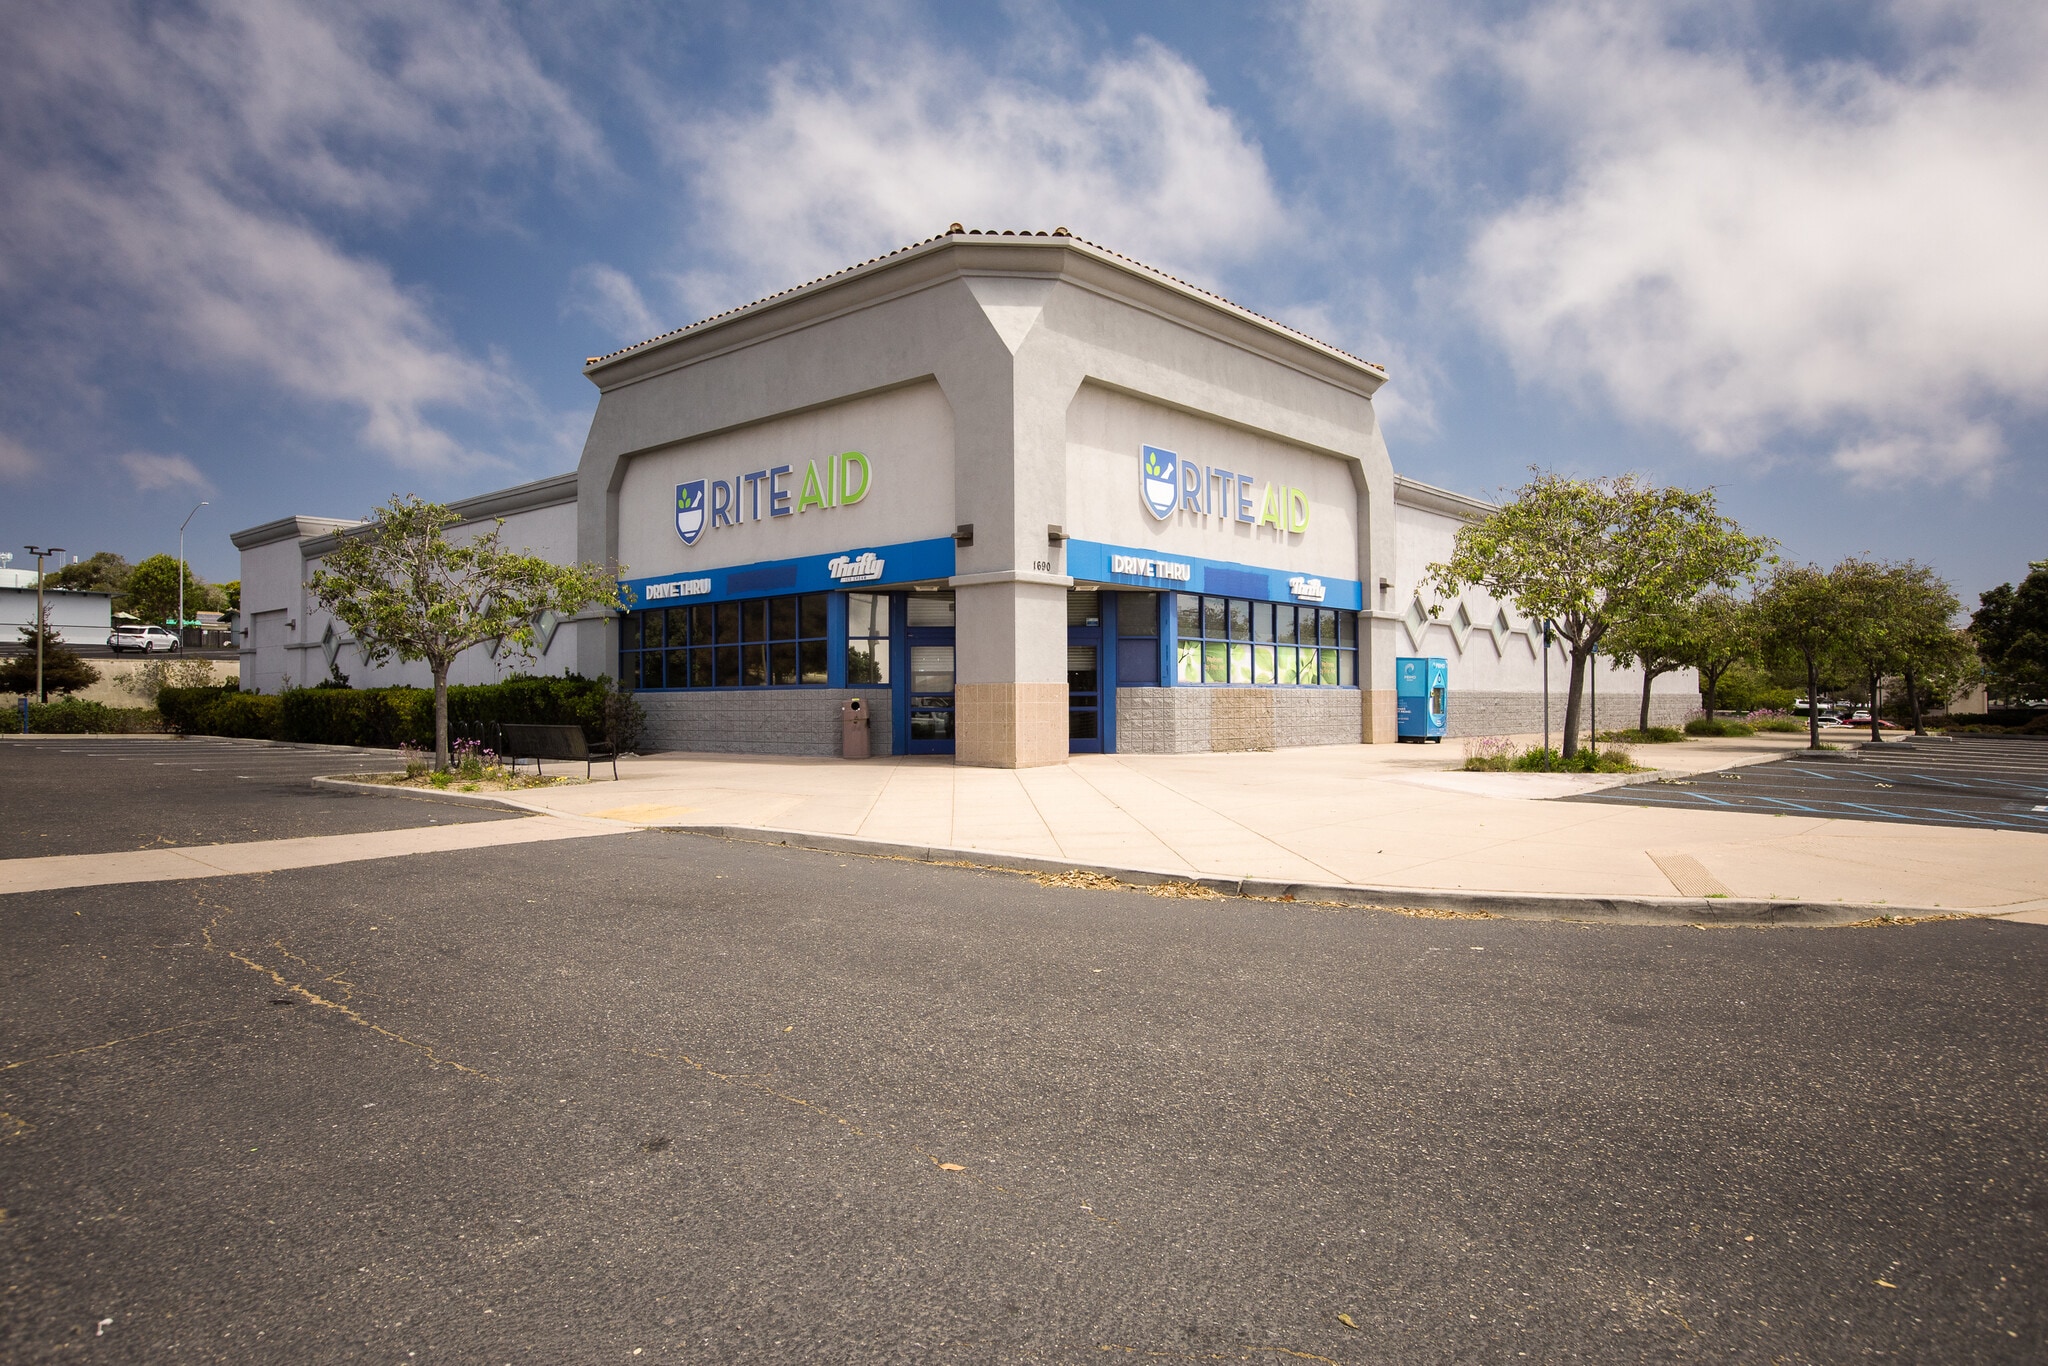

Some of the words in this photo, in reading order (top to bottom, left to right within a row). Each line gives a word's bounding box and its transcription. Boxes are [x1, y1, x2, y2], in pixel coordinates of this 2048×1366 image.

[711, 464, 794, 529] RITE
[797, 450, 873, 514] AID
[1178, 459, 1256, 524] RITE
[1256, 481, 1310, 534] AID
[828, 552, 885, 580] Thrifty
[1033, 560, 1051, 572] 1690
[1111, 554, 1155, 577] DRIVE
[1155, 560, 1191, 582] THRU
[645, 582, 679, 600] DRIVE
[679, 578, 712, 597] THRU
